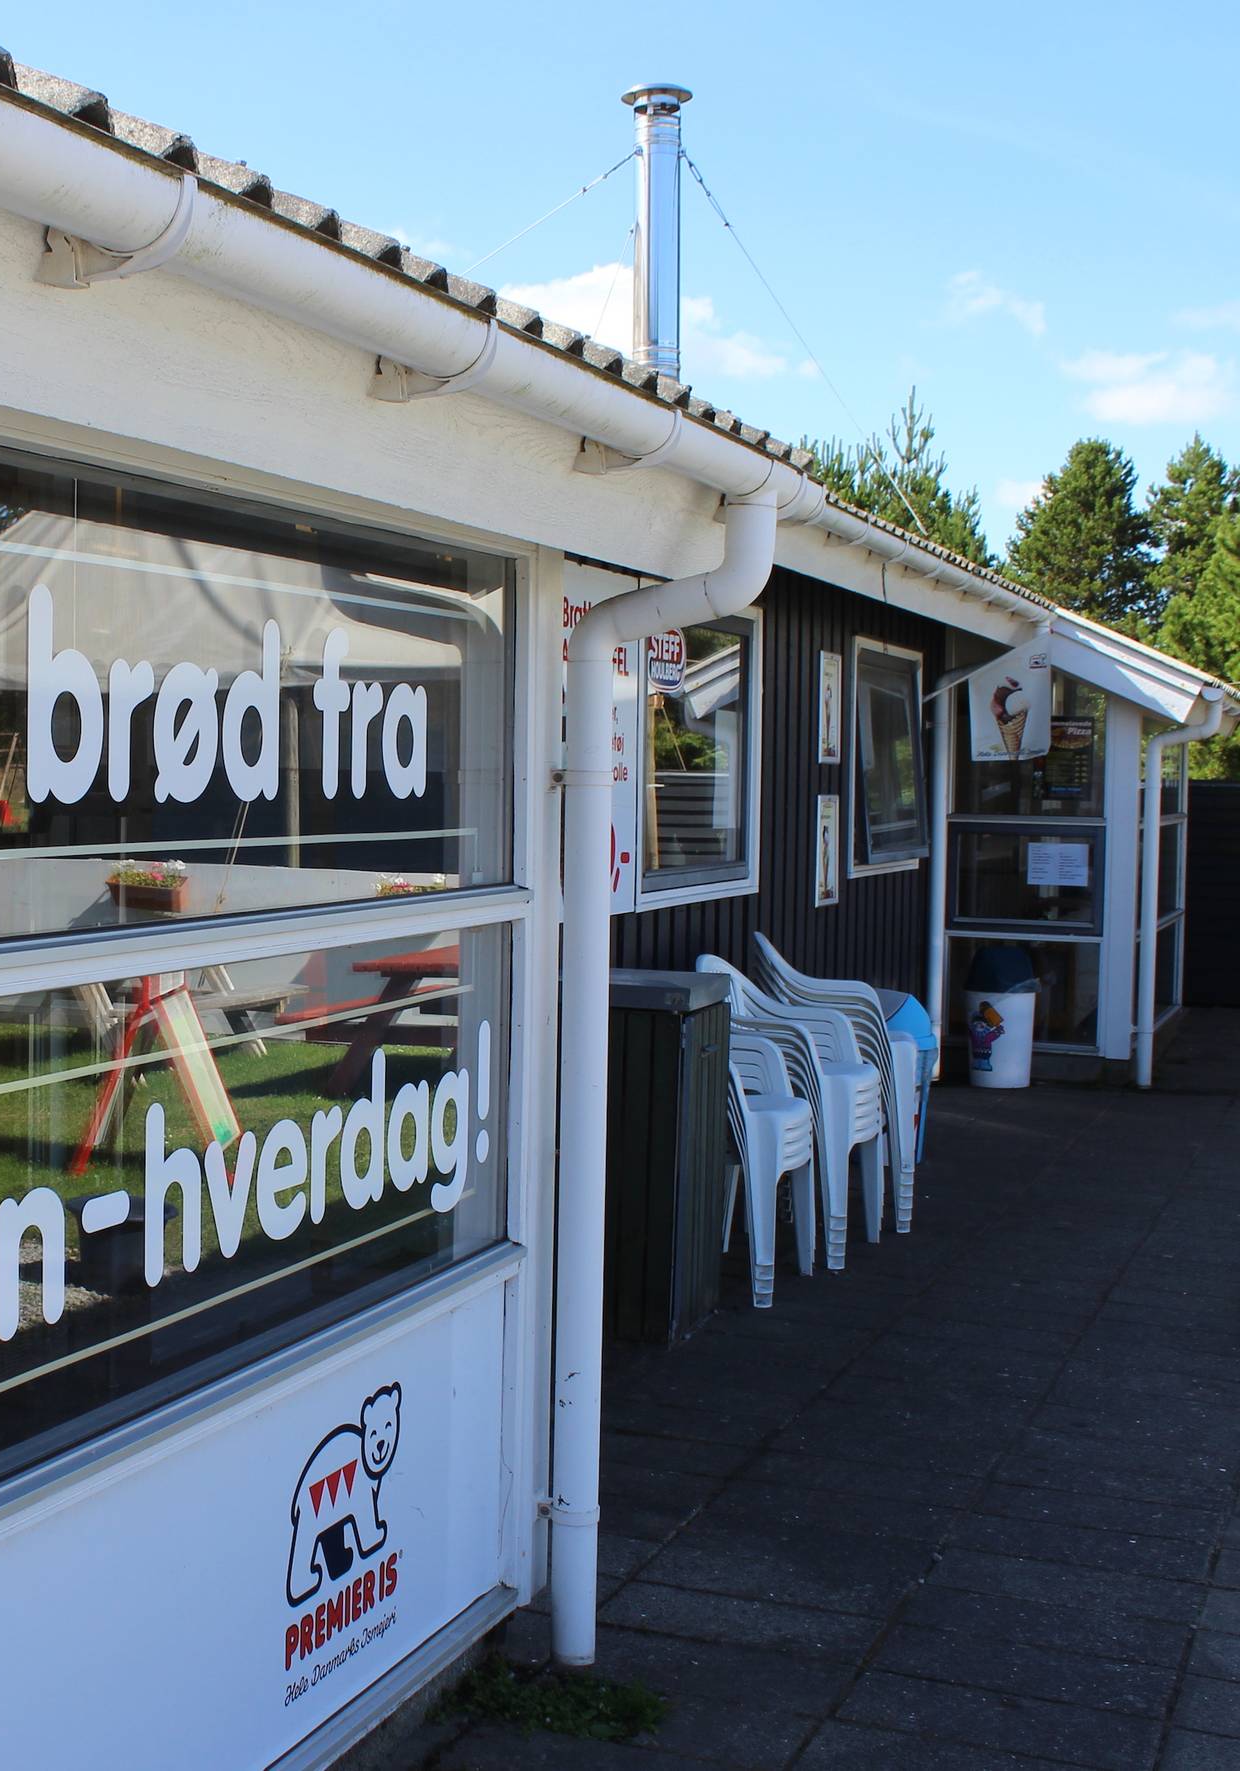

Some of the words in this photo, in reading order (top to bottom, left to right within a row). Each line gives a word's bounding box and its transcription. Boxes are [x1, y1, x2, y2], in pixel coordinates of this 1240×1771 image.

[27, 583, 280, 804] brød
[313, 627, 428, 800] fra
[648, 634, 680, 661] STEFF
[1067, 727, 1092, 735] Pizza
[285, 1570, 375, 1671] PREMIER
[378, 1552, 398, 1602] IS
[285, 1676, 309, 1707] Hele
[311, 1637, 360, 1686] Danmarks
[361, 1606, 397, 1648] Ismejeri
